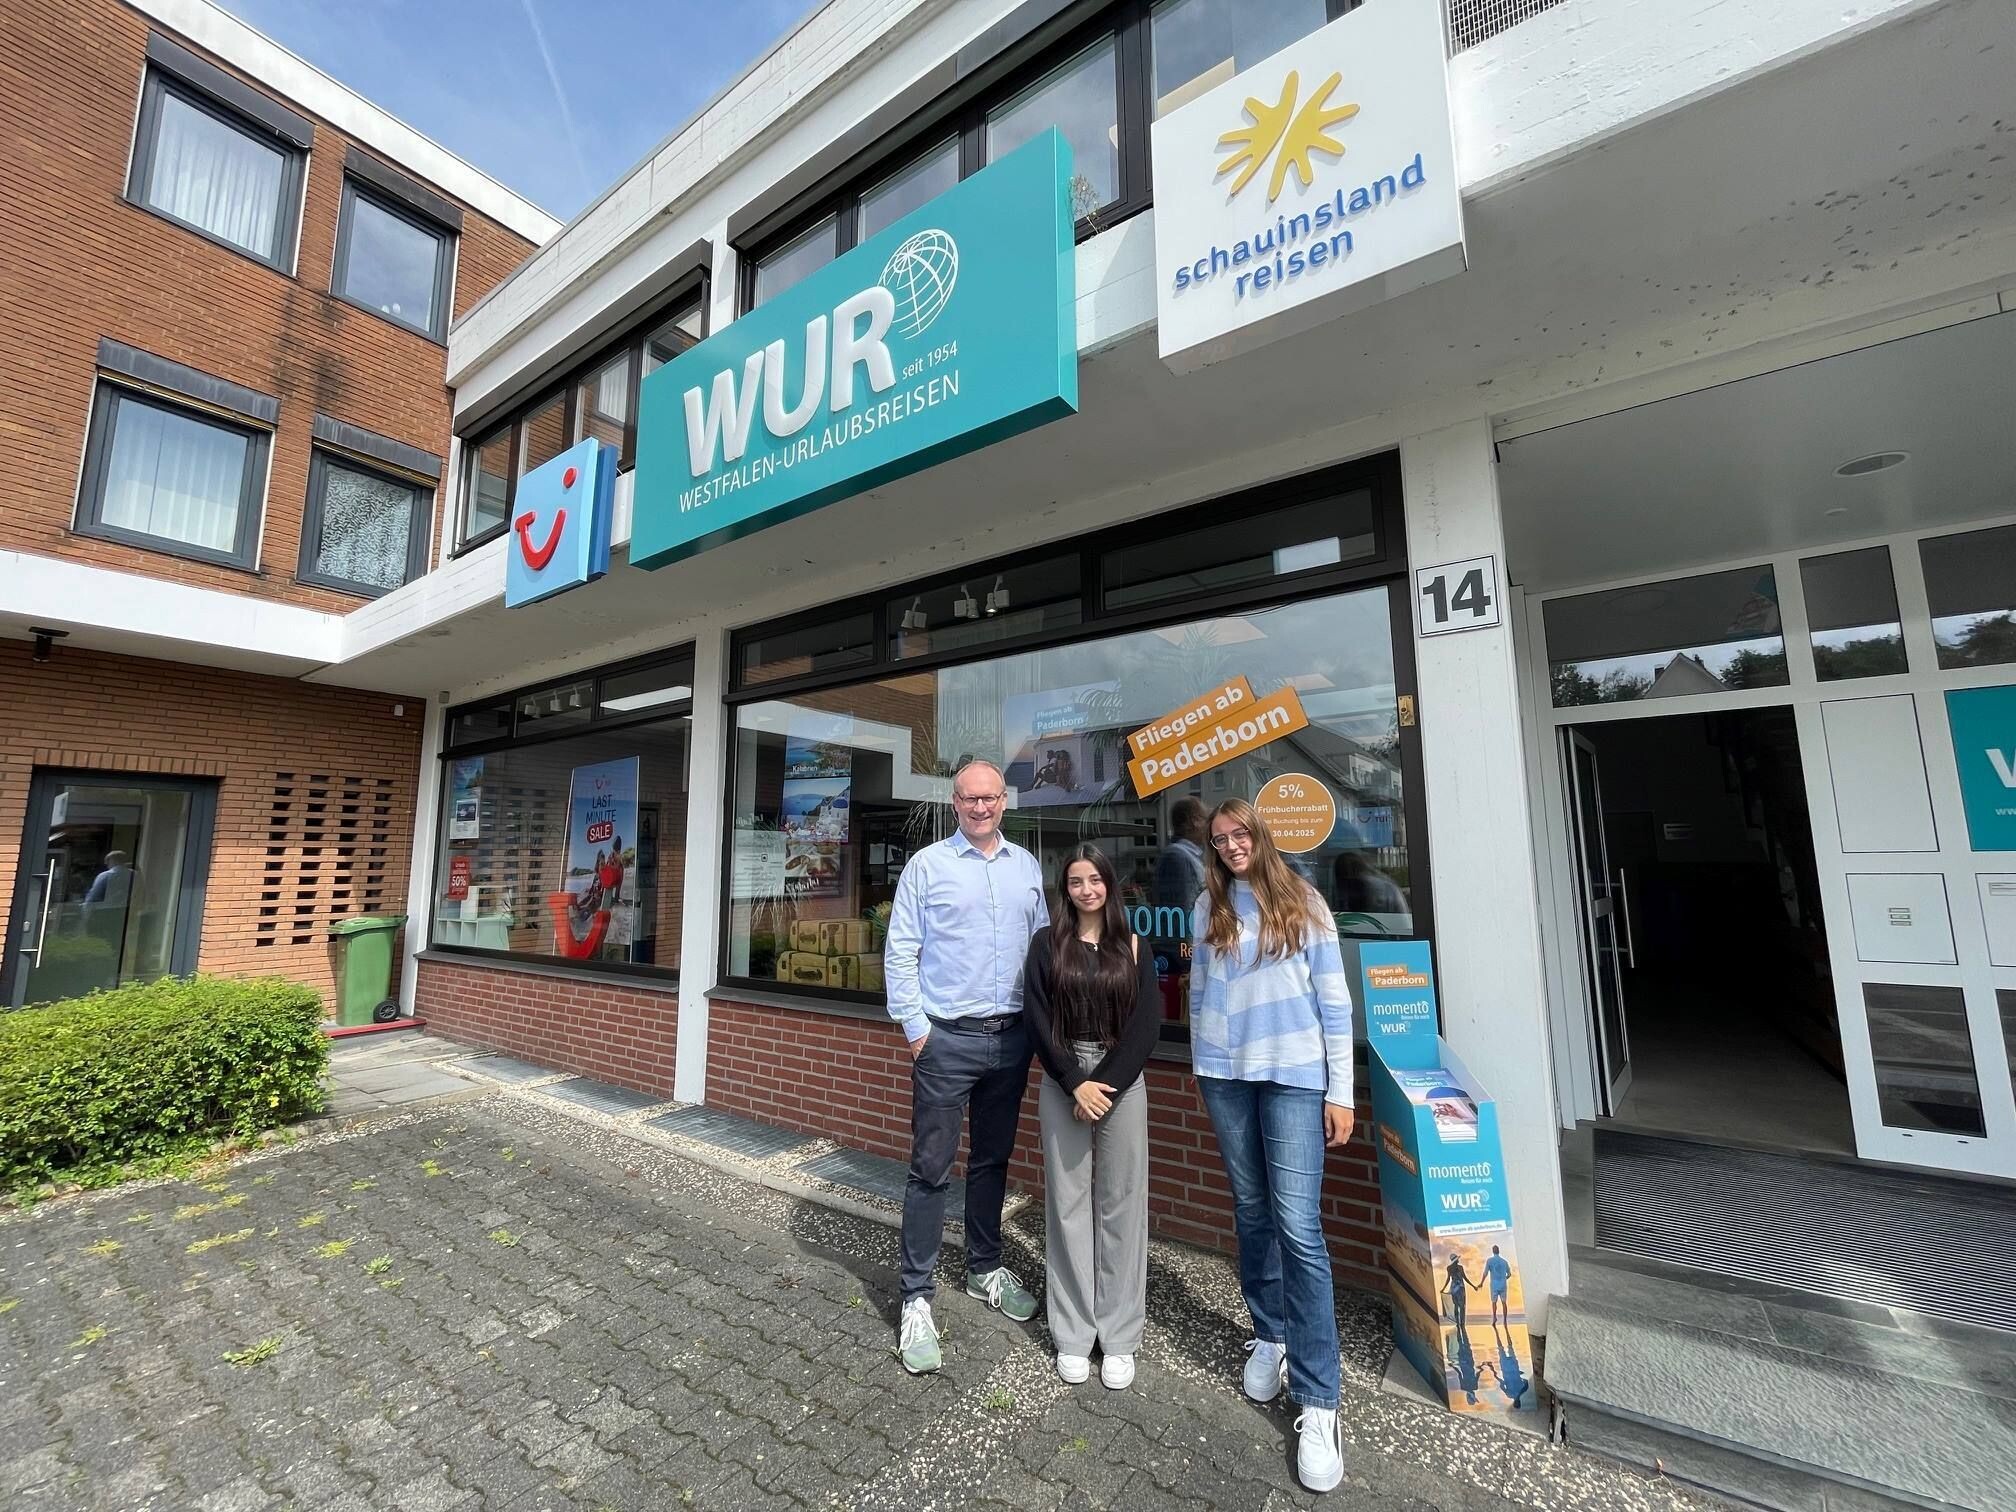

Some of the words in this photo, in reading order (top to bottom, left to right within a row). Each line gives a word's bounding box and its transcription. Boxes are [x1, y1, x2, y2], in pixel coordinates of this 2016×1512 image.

[1175, 153, 1426, 290] schauinsland
[1235, 229, 1355, 298] reisen
[902, 357, 924, 380] seit
[927, 340, 958, 367] 1954
[683, 285, 897, 477] WUR
[679, 369, 959, 513] WESTFALEN-URLAUBSREISEN
[1422, 568, 1492, 623] 14
[1037, 716, 1084, 730] Paderborn
[1135, 704, 1212, 751] Fliegen
[1215, 686, 1244, 711] ab
[1140, 705, 1291, 785] Paderborn
[1278, 783, 1305, 799] 5%
[592, 794, 612, 809] LAST
[585, 809, 617, 824] MINUTE
[589, 824, 611, 841] SALE
[1272, 829, 1315, 838] 30.04.2025
[451, 875, 467, 887] 50%
[1375, 976, 1425, 985] Paderborn
[1380, 1023, 1407, 1034] WUR
[1440, 1193, 1482, 1209] WUR
